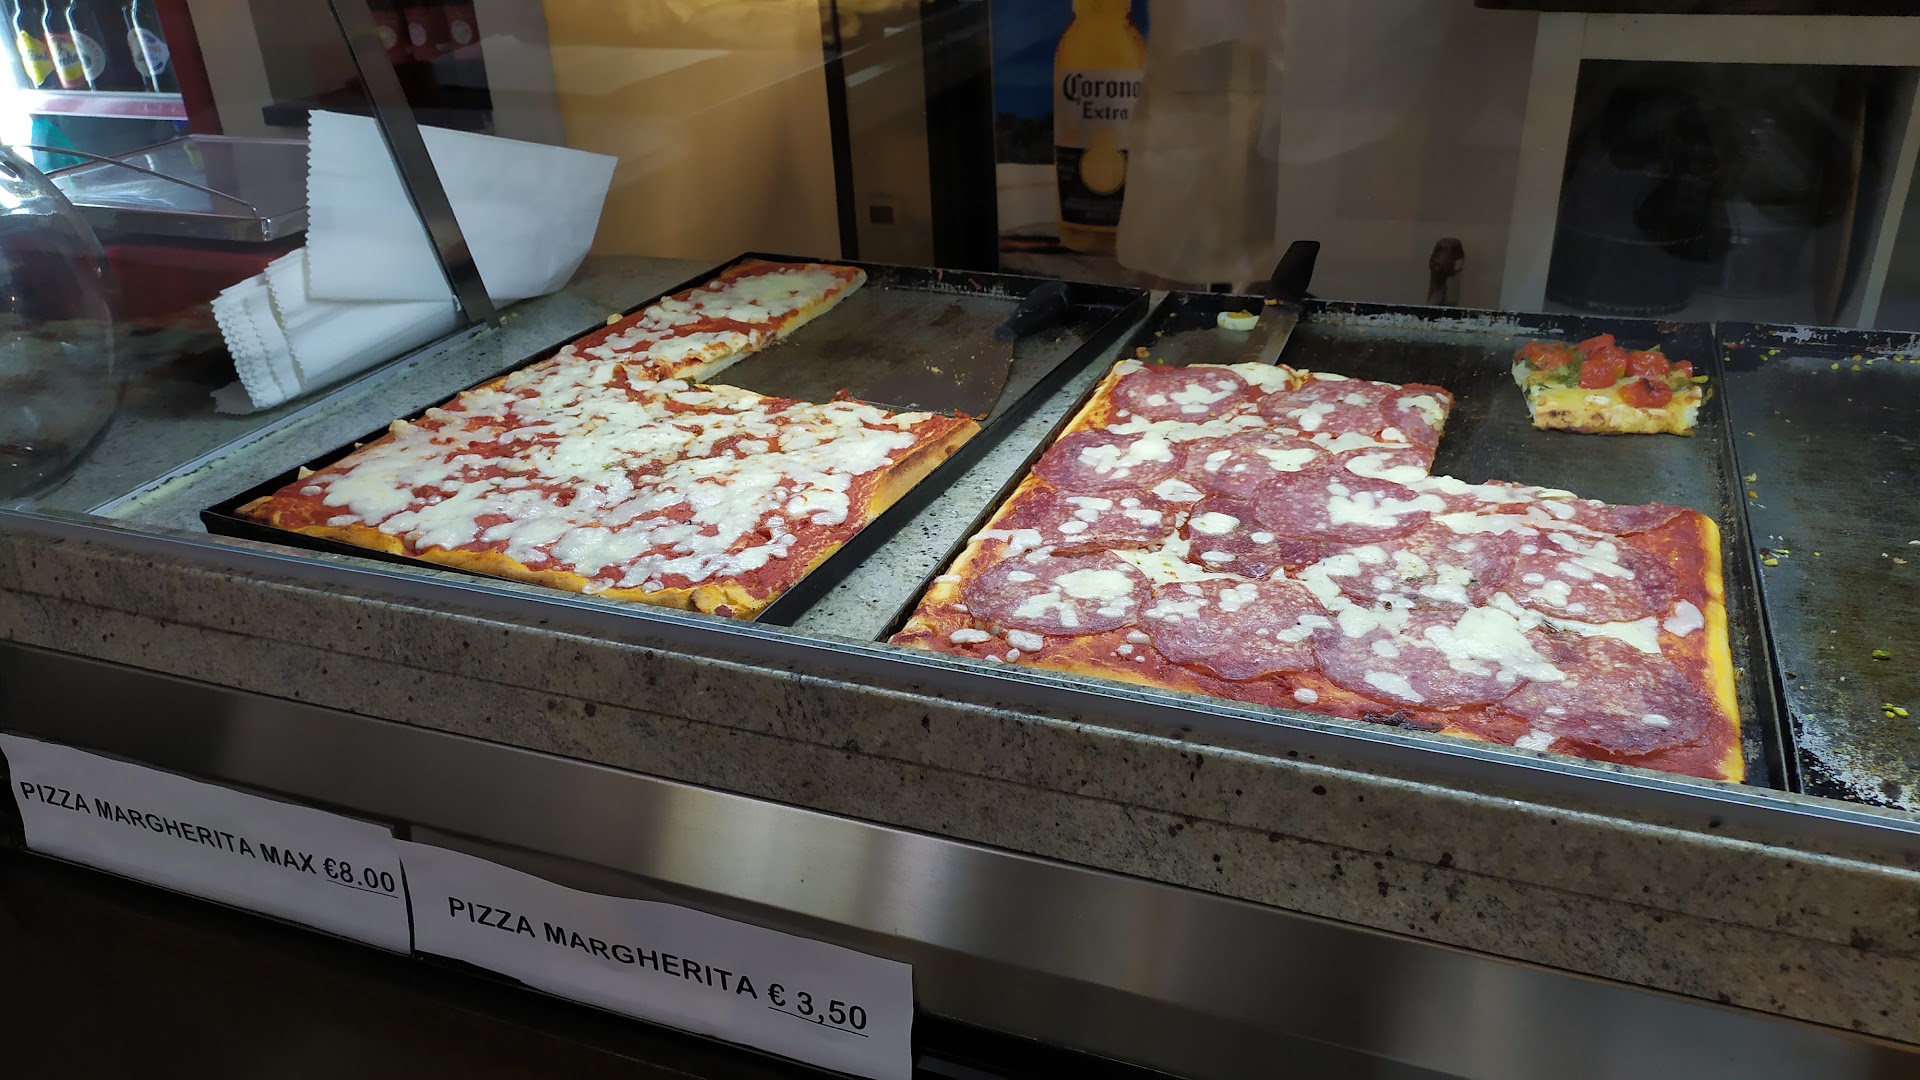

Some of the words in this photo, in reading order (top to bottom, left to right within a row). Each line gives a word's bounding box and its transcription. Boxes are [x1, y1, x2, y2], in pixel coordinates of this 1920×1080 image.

[1082, 101, 1129, 120] Extra
[20, 781, 91, 815] PIZZA
[94, 798, 256, 859] MARGHERITA
[259, 842, 317, 876] MAX
[322, 856, 396, 894] €8.00
[448, 896, 536, 939] PIZZA
[543, 921, 758, 1001] MARGHERITA
[767, 983, 788, 1007] €
[796, 990, 868, 1031] 3,50
